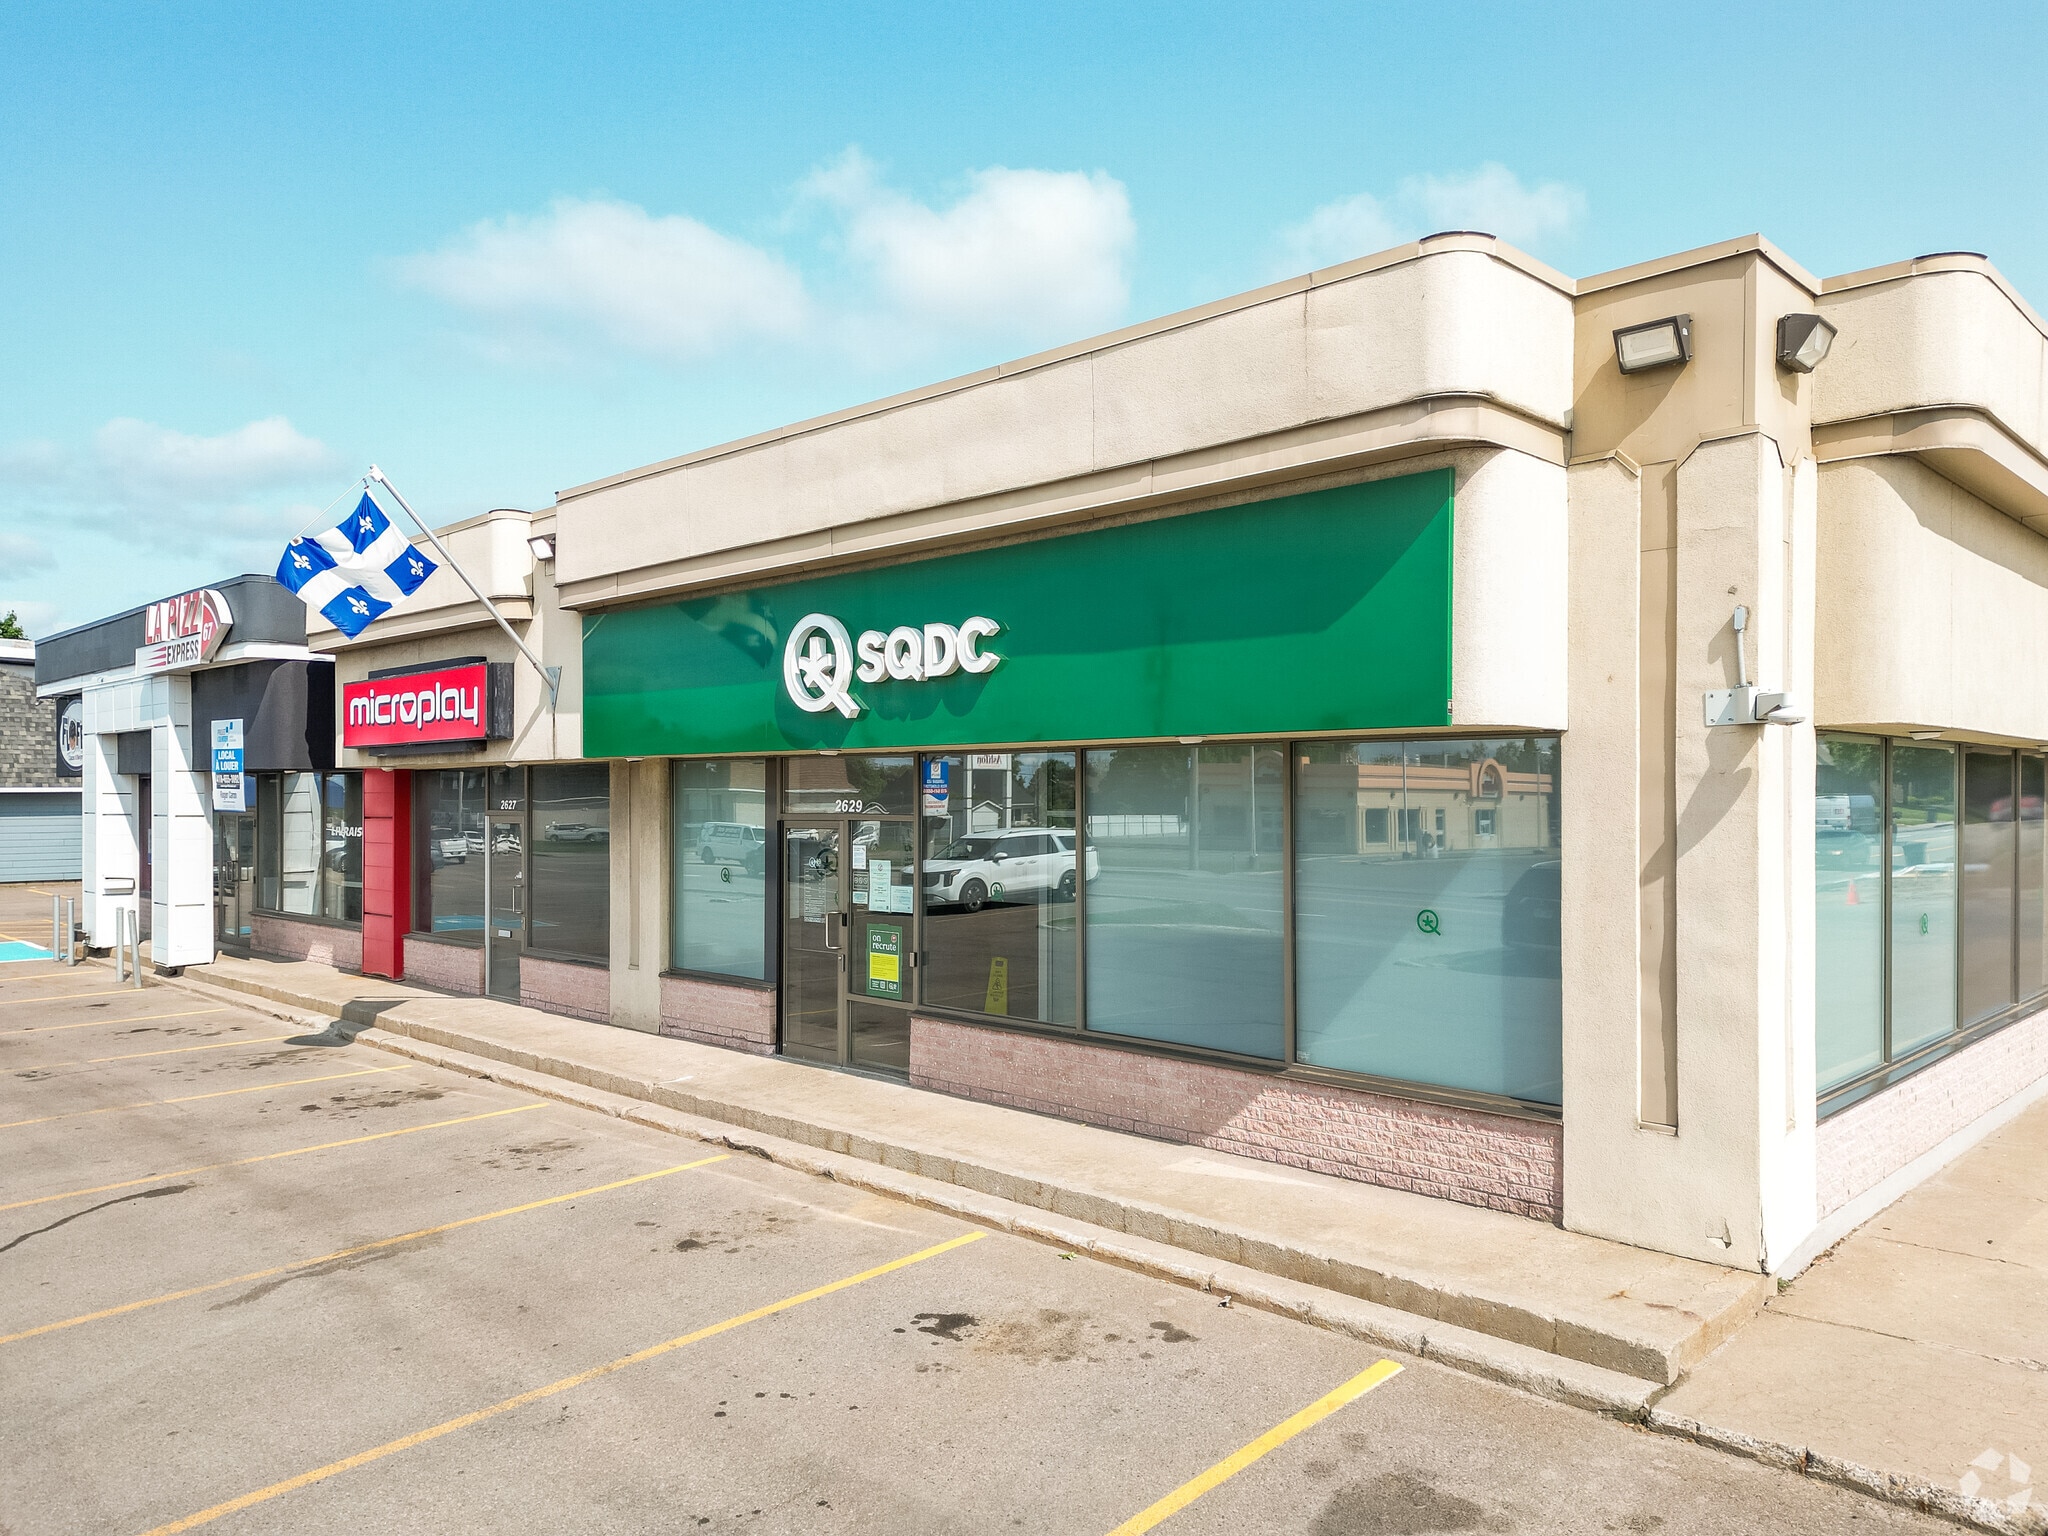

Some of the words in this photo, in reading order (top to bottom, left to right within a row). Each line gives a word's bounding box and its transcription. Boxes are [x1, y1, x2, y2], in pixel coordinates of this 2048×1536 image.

[145, 603, 162, 645] LA
[166, 640, 199, 664] EXPRESS
[856, 615, 1001, 684] SQDC
[350, 682, 479, 730] microplay
[217, 750, 236, 760] LOCAL
[215, 759, 221, 770] À
[220, 761, 239, 771] LOUER
[500, 800, 517, 810] 2627
[835, 799, 863, 813] 2629
[872, 934, 882, 942] on
[872, 942, 897, 951] recrute
